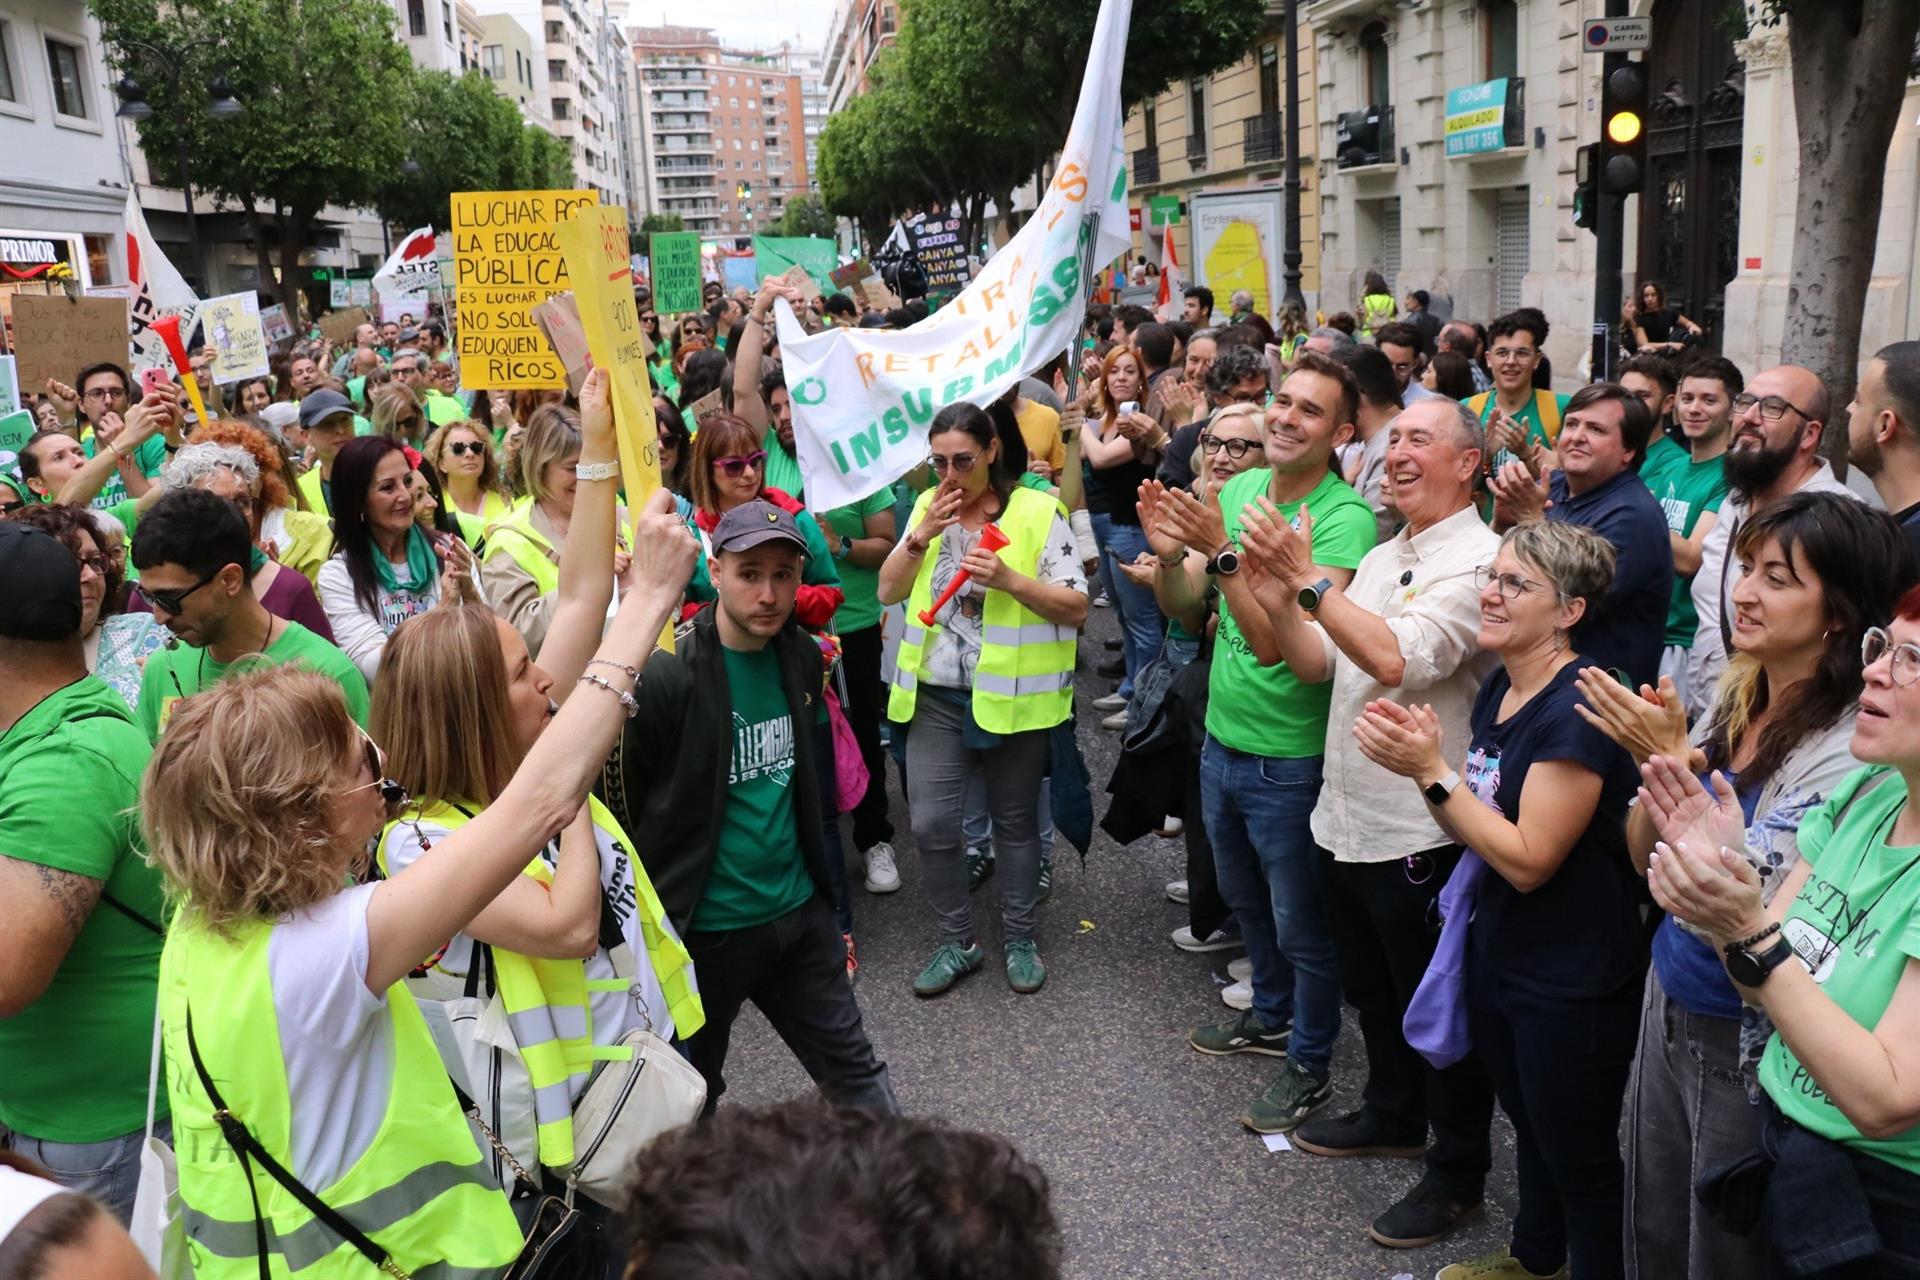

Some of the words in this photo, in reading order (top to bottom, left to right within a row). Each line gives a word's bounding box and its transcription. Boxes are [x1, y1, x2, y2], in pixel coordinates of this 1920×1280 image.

[1448, 110, 1494, 131] ALQUILADO
[457, 199, 547, 227] LUCHAR
[2, 239, 58, 263] PRIMOR
[457, 234, 483, 253] LA
[657, 255, 668, 265] NI
[918, 247, 955, 261] CANYA
[460, 291, 477, 304] ES
[486, 291, 537, 304] LUCHAR
[461, 311, 489, 330] NO
[462, 336, 537, 356] EDUQUEN
[741, 769, 759, 782] ES
